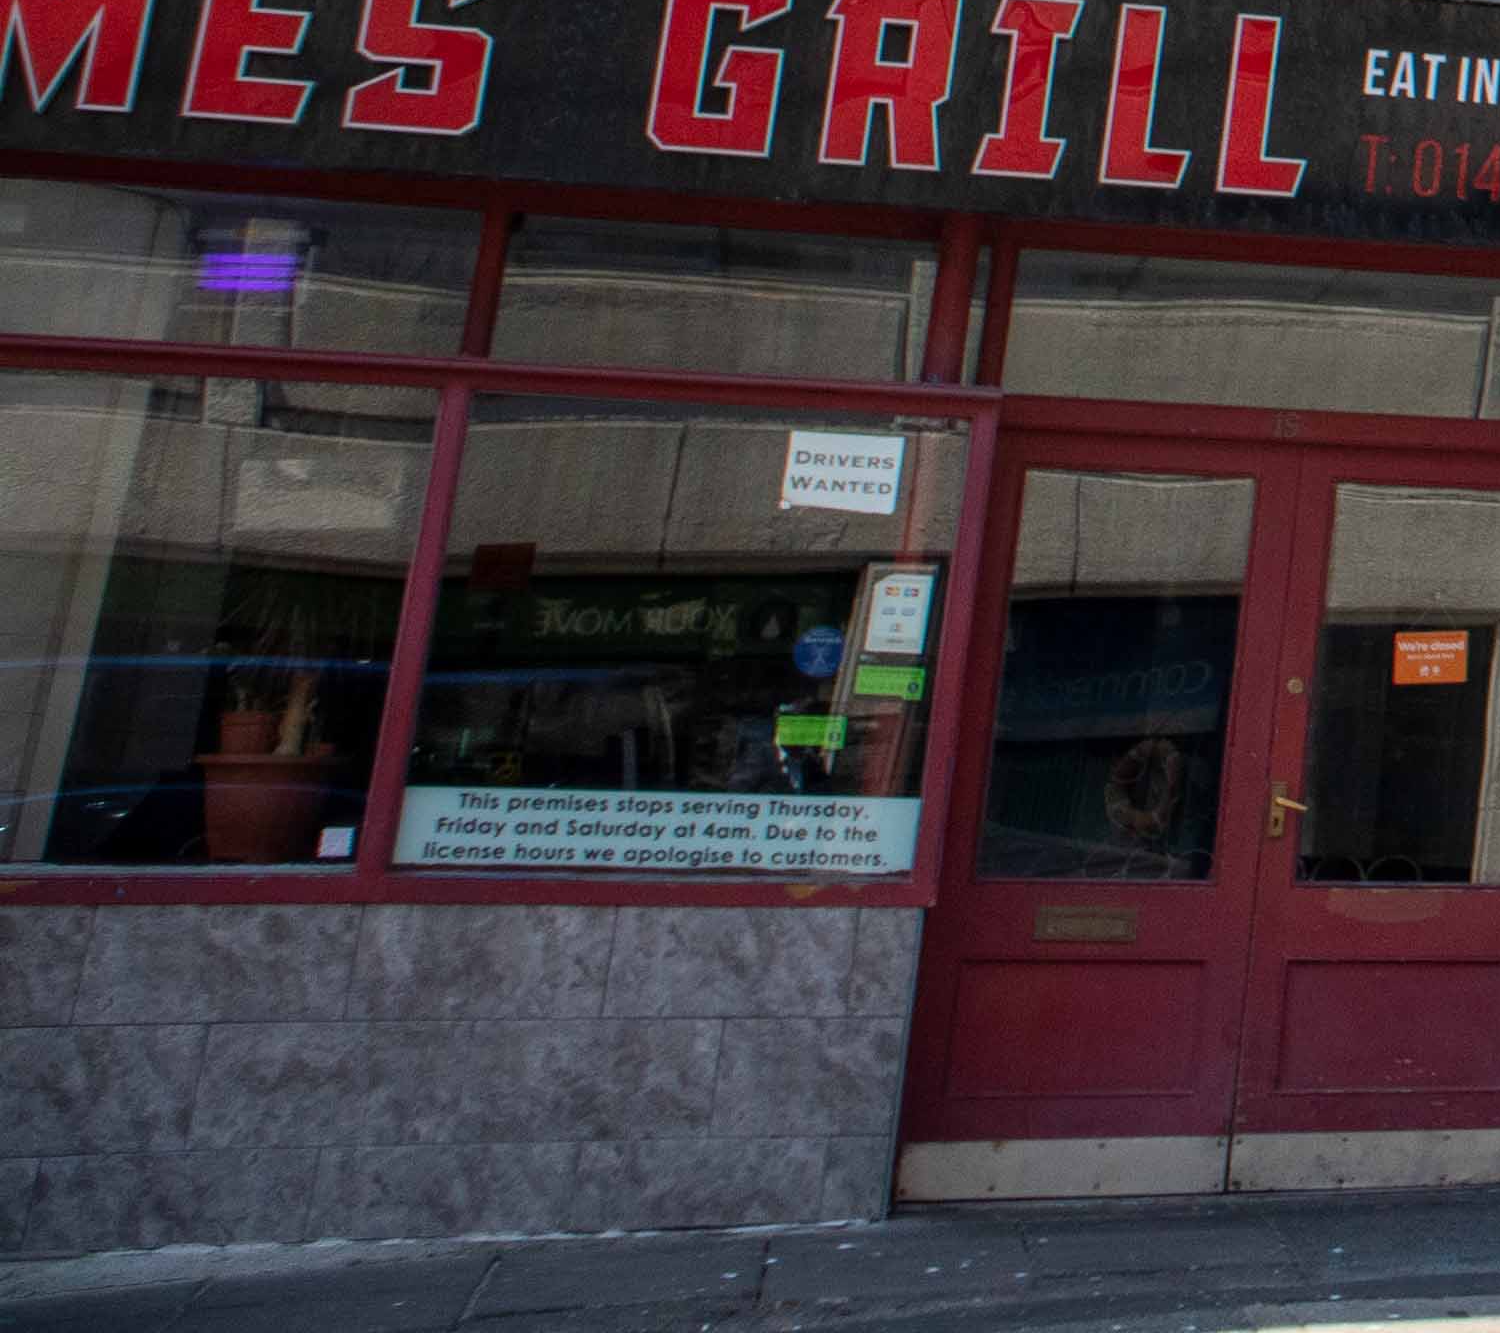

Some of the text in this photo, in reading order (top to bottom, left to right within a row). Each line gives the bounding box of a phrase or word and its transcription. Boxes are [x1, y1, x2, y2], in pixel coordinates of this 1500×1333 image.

[1362, 48, 1447, 101] EAT
[1360, 133, 1398, 195] T:
[794, 450, 896, 470] DRIVERS
[789, 475, 893, 496] WANTED
[459, 792, 500, 810] This
[506, 793, 608, 814] premises
[615, 797, 675, 816] stops
[681, 799, 761, 820] serving
[435, 817, 878, 843] Friday and Saturday at 4am. Due to the
[422, 841, 889, 869] license hours we apologise to customers.
